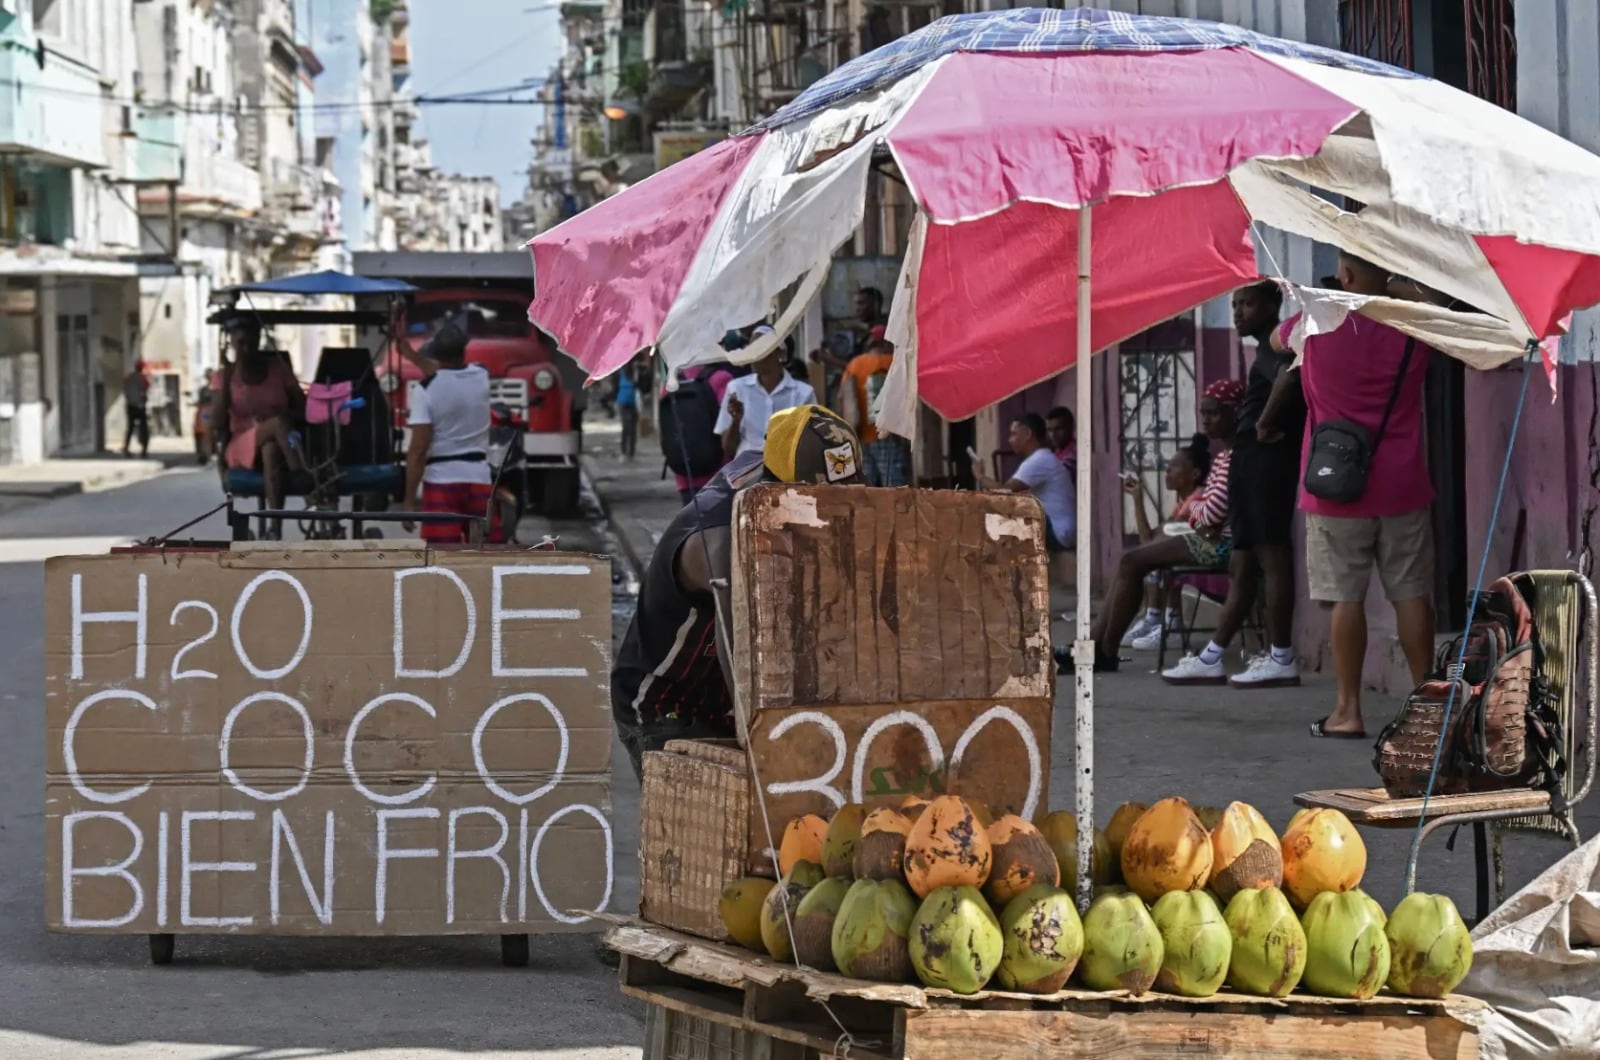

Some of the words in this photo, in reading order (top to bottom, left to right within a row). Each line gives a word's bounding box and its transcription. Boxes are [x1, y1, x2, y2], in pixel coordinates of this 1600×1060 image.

[70, 571, 312, 680] H2O
[394, 566, 591, 679] DE
[63, 689, 570, 804] COCO
[63, 808, 334, 928] BIEN
[376, 804, 614, 924] FRIO
